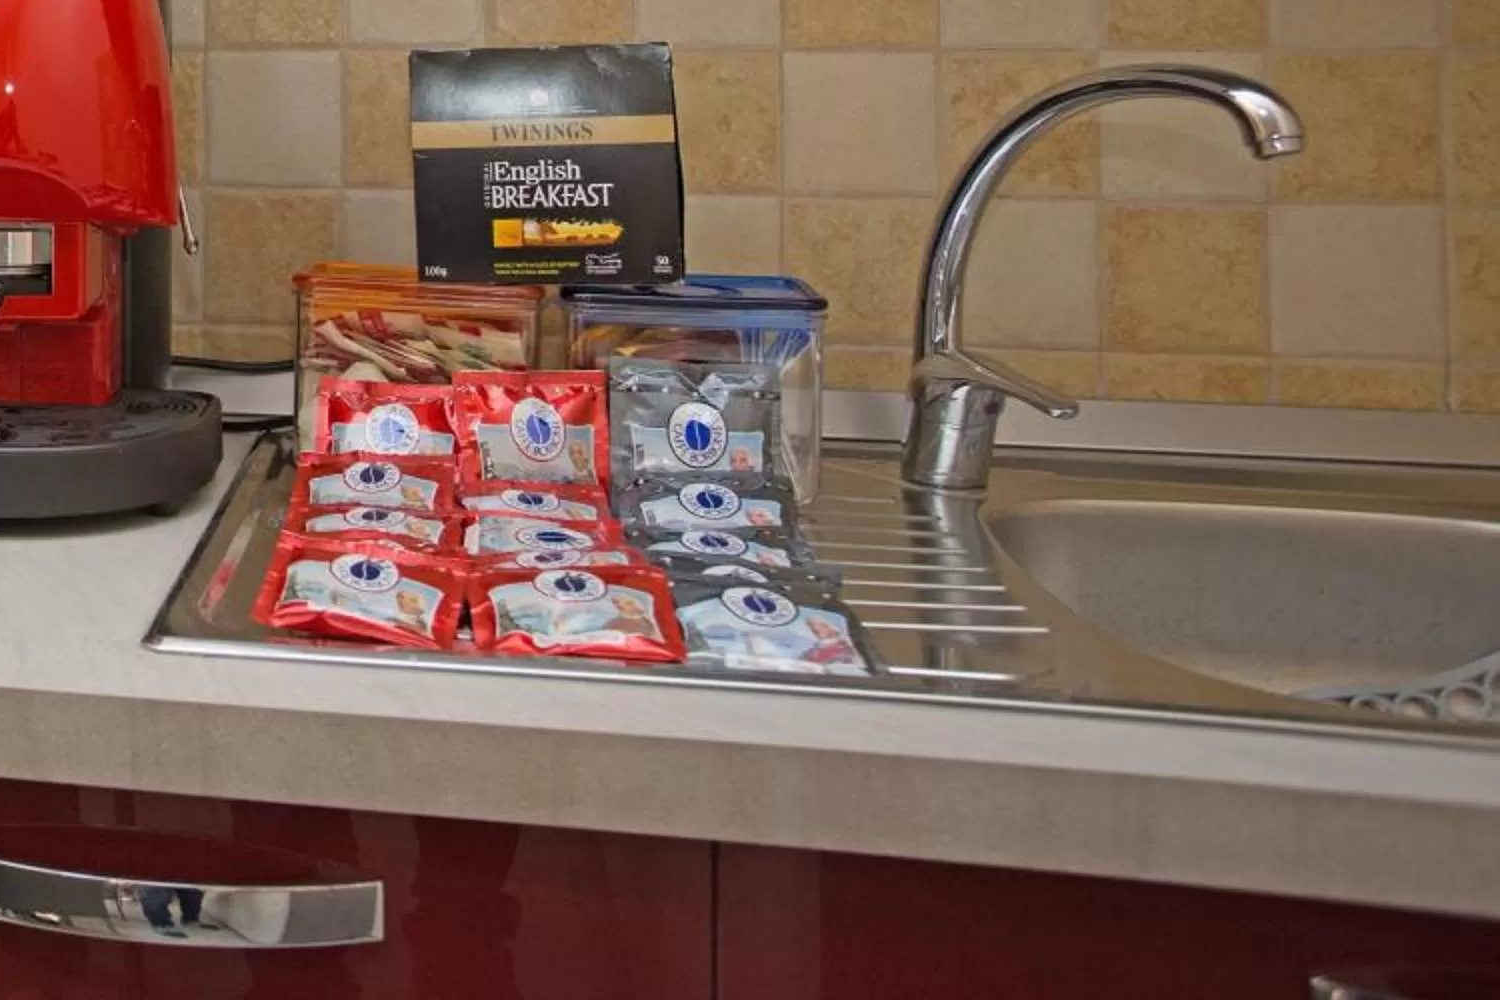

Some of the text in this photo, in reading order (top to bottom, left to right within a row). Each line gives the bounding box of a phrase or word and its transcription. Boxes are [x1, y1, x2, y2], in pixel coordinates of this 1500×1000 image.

[491, 121, 594, 143] TWININGS
[494, 159, 581, 185] English
[491, 183, 615, 209] BREAKFAST
